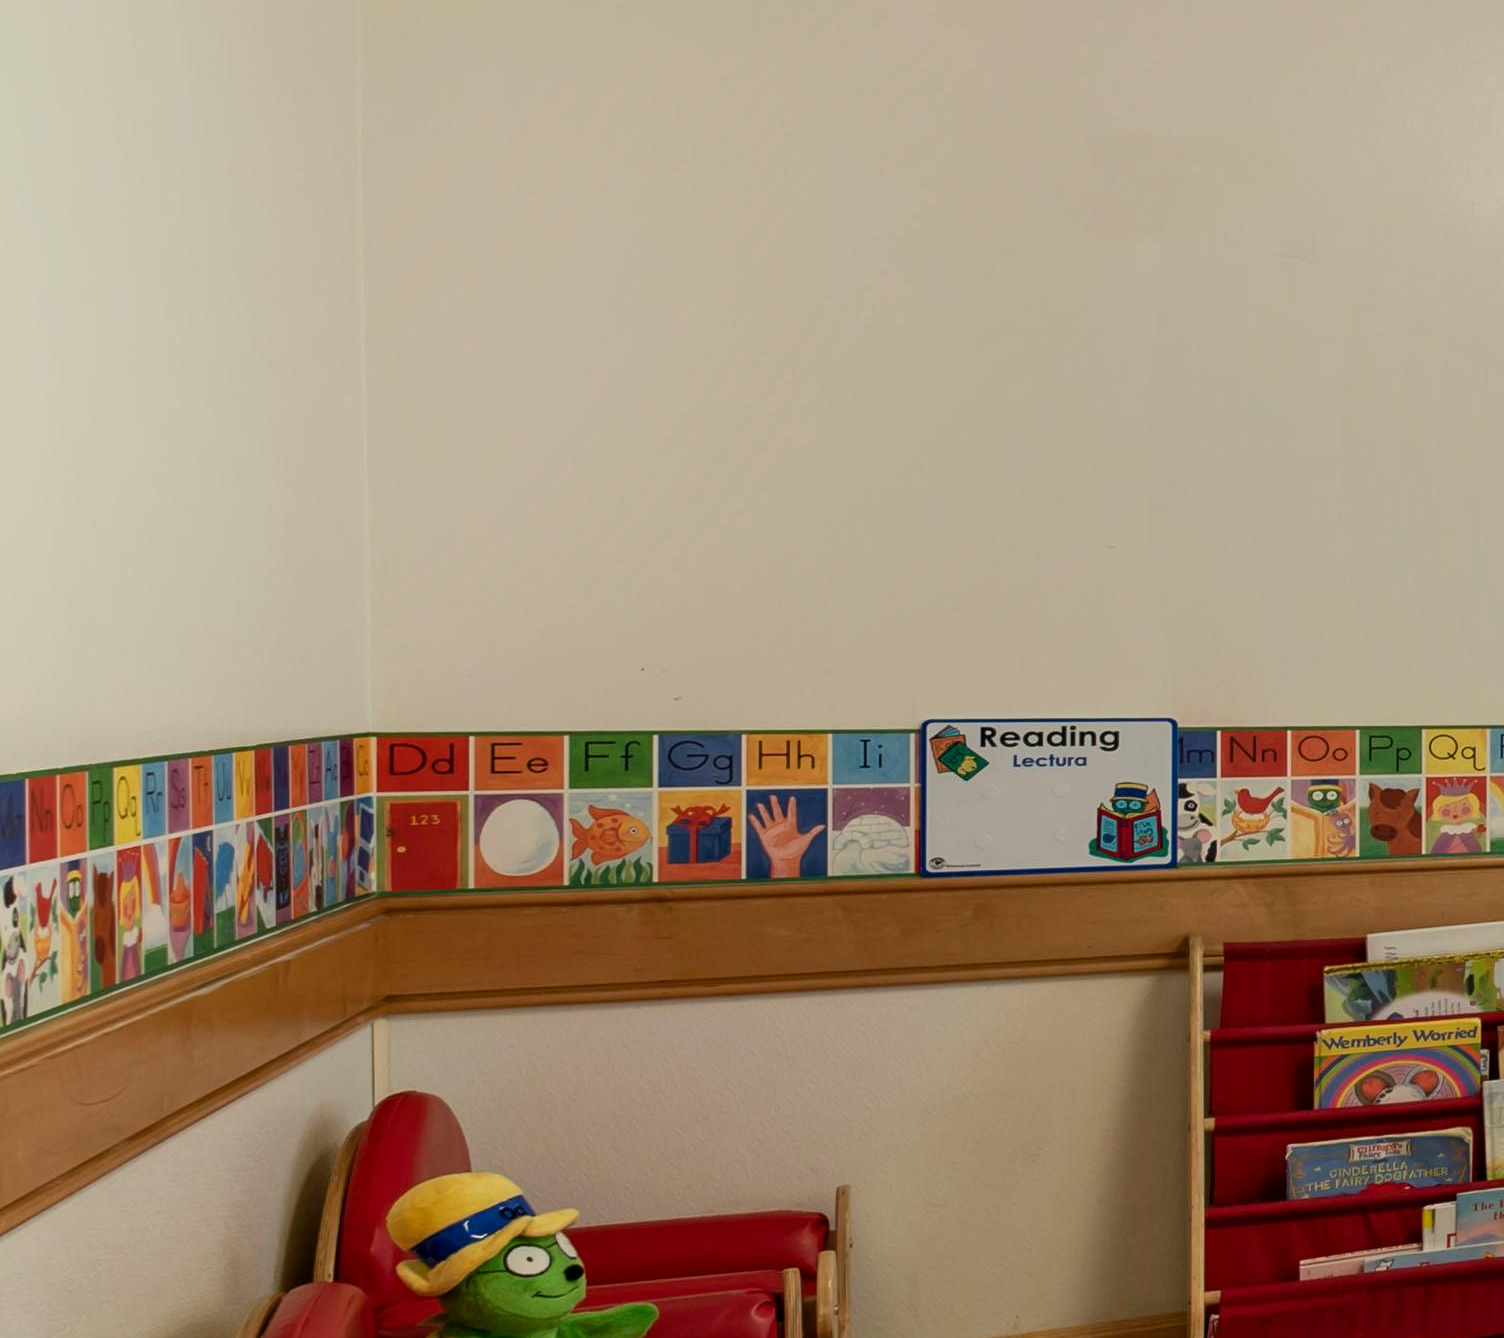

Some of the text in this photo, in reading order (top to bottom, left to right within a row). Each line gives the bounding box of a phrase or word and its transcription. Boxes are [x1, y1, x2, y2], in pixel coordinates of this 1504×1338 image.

[980, 726, 1120, 751] Reading
[1229, 737, 1278, 764] Nn
[1298, 736, 1348, 764] Oo
[389, 742, 455, 776] Dd
[490, 742, 549, 775] Ee
[584, 740, 640, 773] Ff
[666, 738, 734, 785] Gg
[757, 736, 814, 770] Hh
[859, 739, 883, 768] Ii
[1013, 755, 1087, 768] Lectura
[1368, 735, 1412, 772] Pp
[1429, 735, 1485, 773] Qq
[410, 814, 441, 827] 123
[1322, 1026, 1478, 1050] Wemberly Worried
[1307, 1167, 1448, 1192] THE FAIRY DOGFATHER
[1329, 1162, 1408, 1178] CINDERELLA
